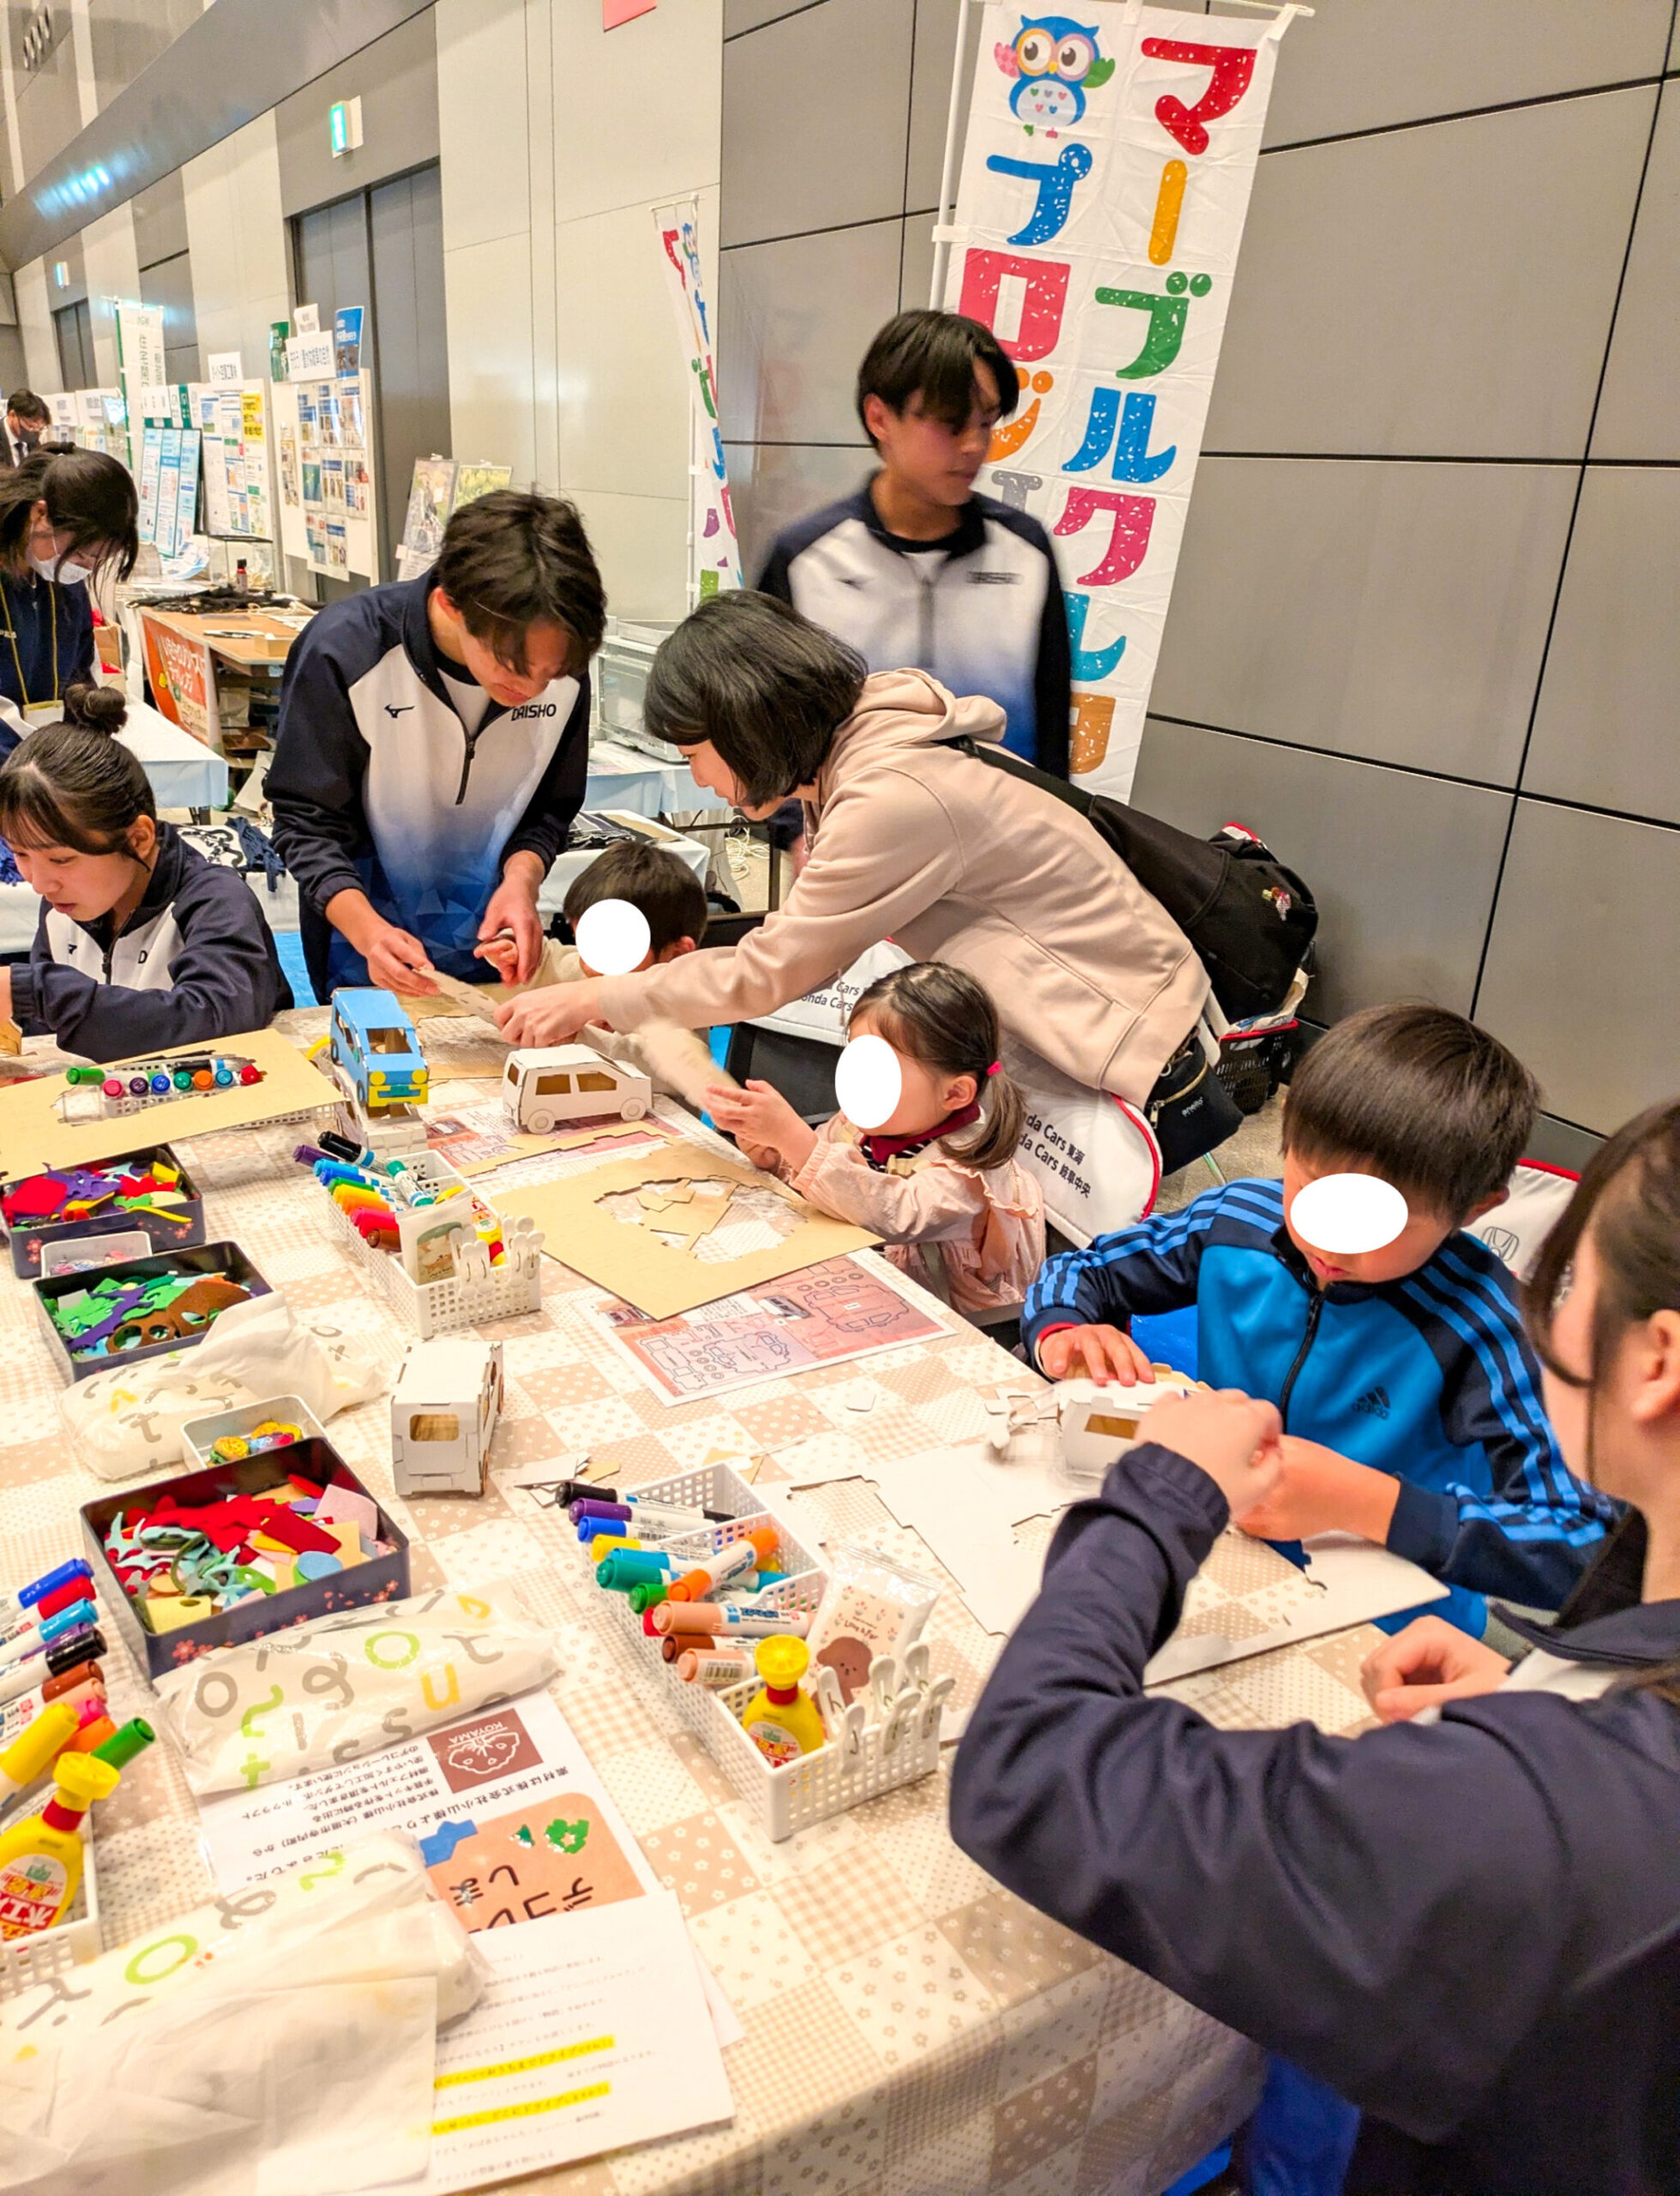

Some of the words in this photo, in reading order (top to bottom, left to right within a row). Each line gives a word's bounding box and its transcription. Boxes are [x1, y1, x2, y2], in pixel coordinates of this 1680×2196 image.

[511, 703, 557, 721] DAISHO
[801, 993, 828, 1005] onda
[1044, 1124, 1067, 1151] Cars
[1066, 1143, 1086, 1166] 東海
[1034, 1143, 1059, 1171] Cars
[1058, 1163, 1092, 1199] 岐阜中央
[449, 1721, 503, 1744] KOYAMA
